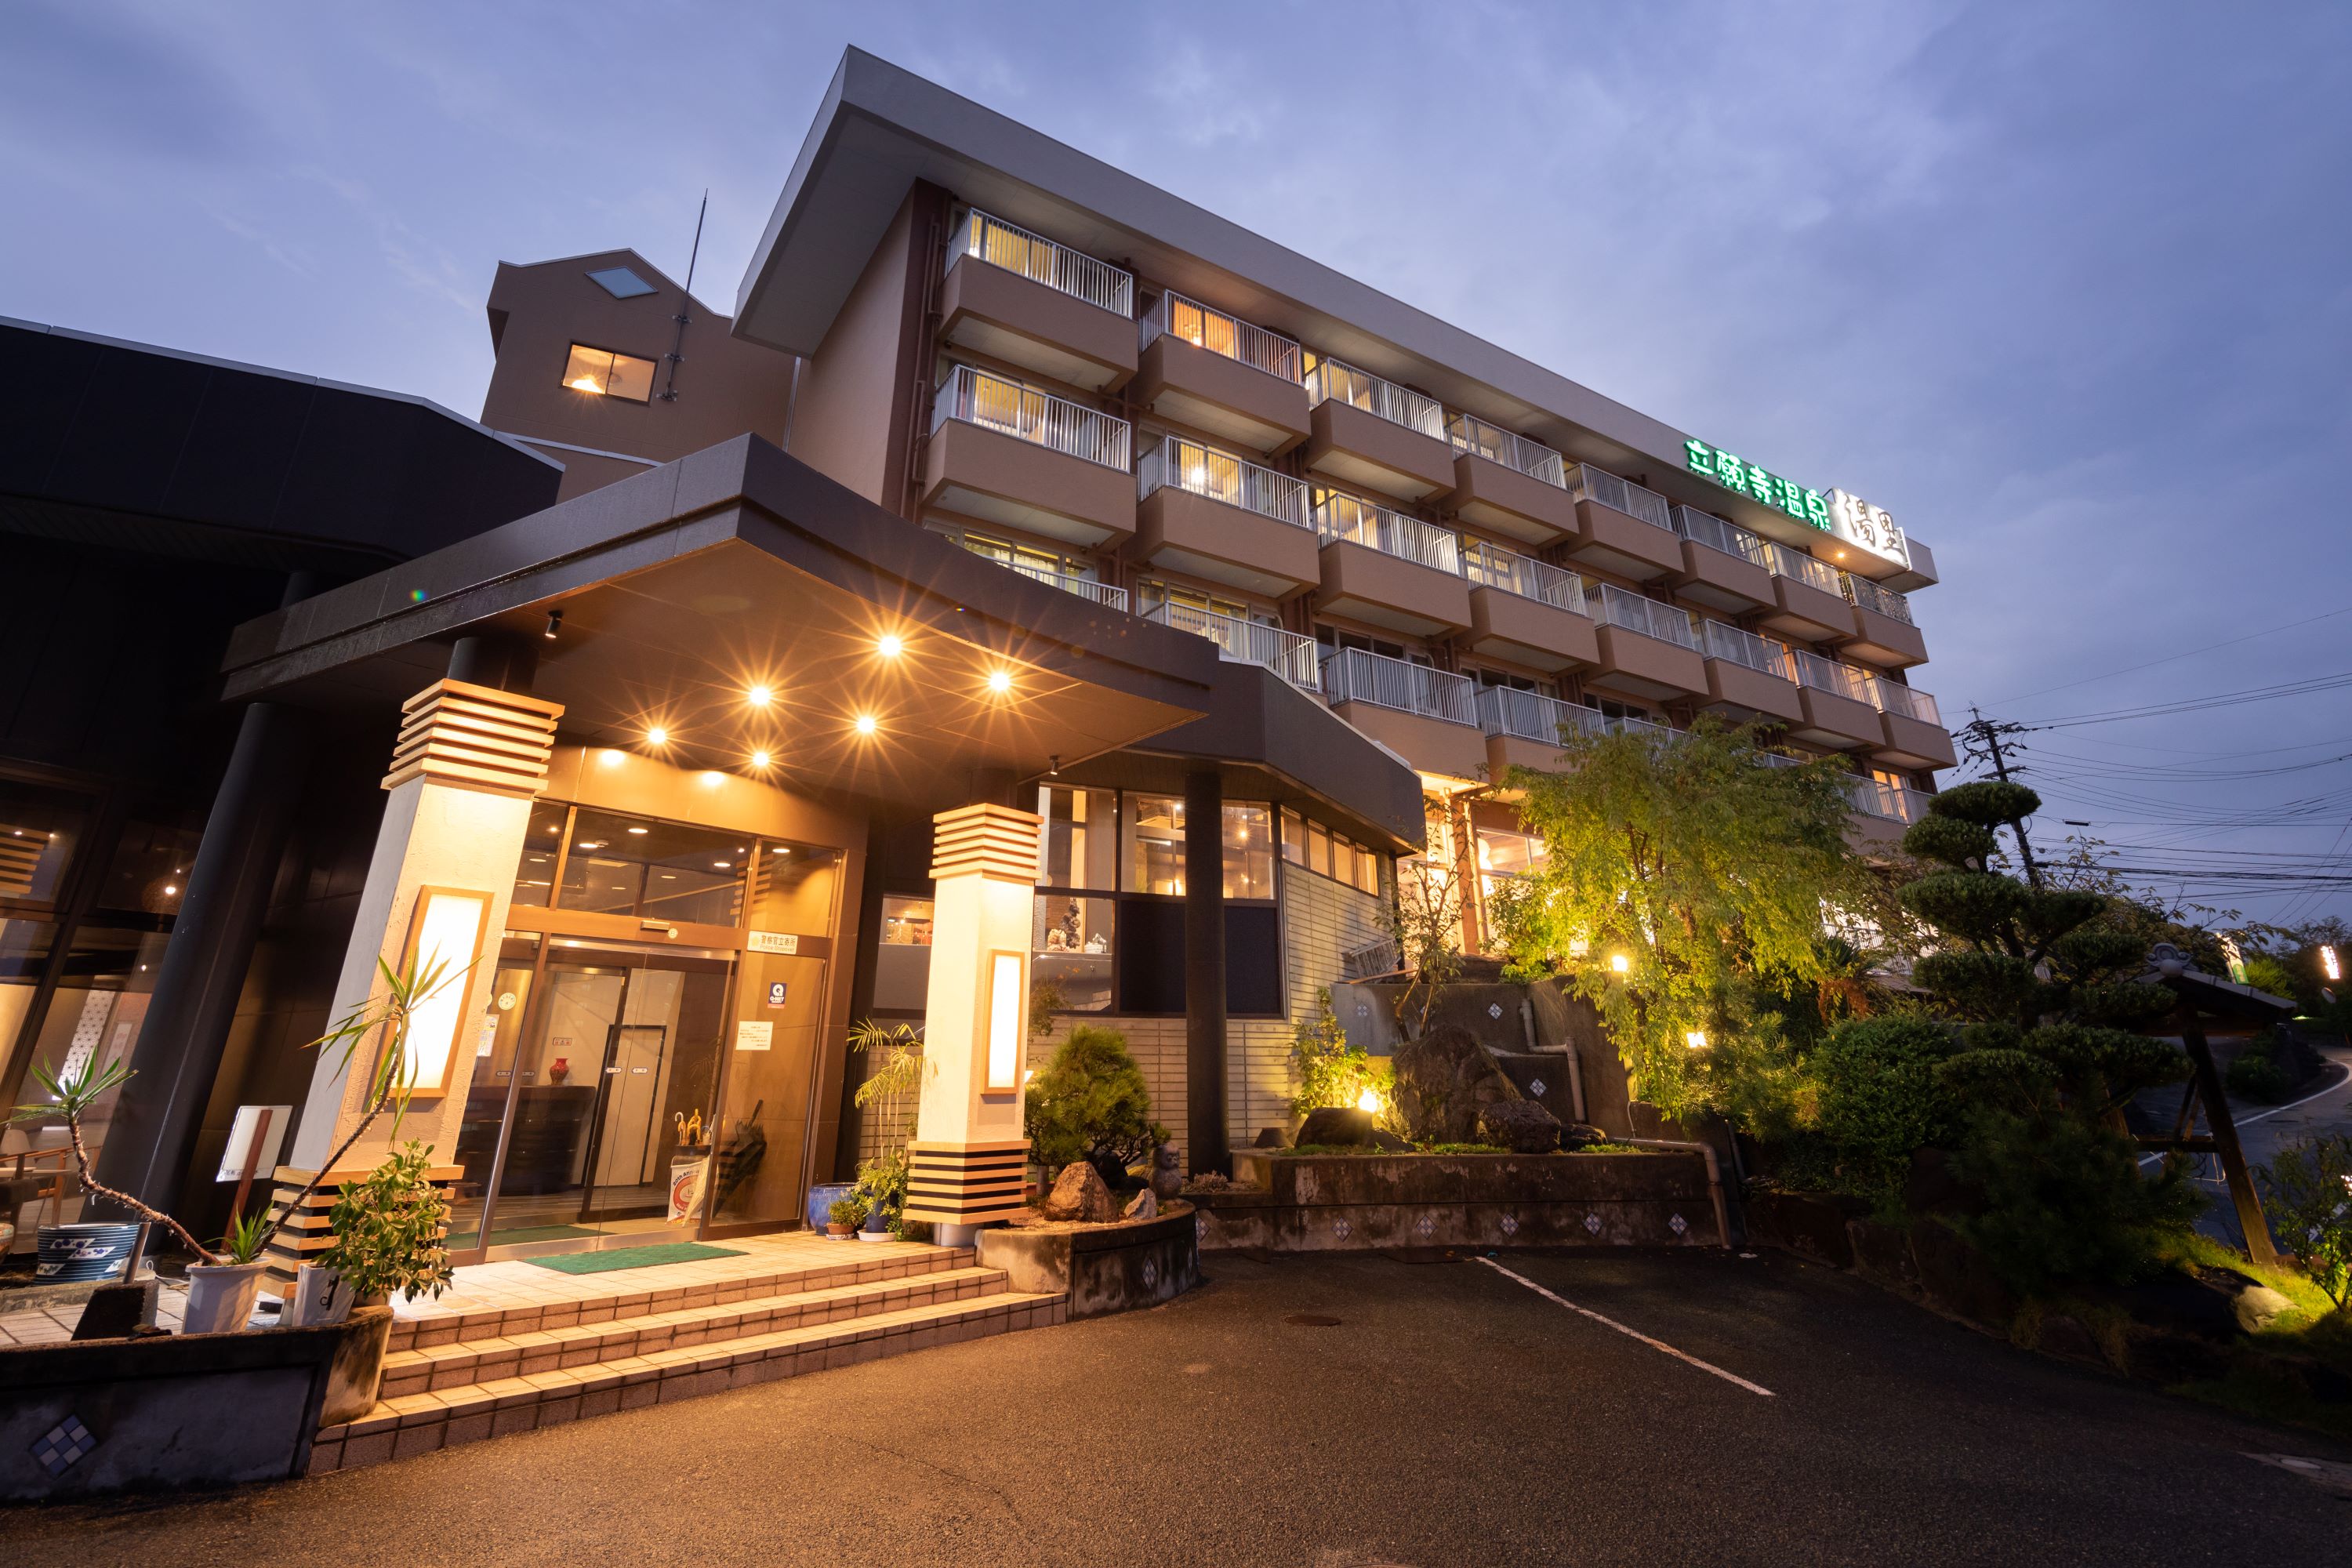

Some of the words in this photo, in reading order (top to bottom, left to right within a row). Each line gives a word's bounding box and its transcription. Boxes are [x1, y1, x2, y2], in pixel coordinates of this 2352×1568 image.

[1685, 440, 1831, 531] 立願寺温泉
